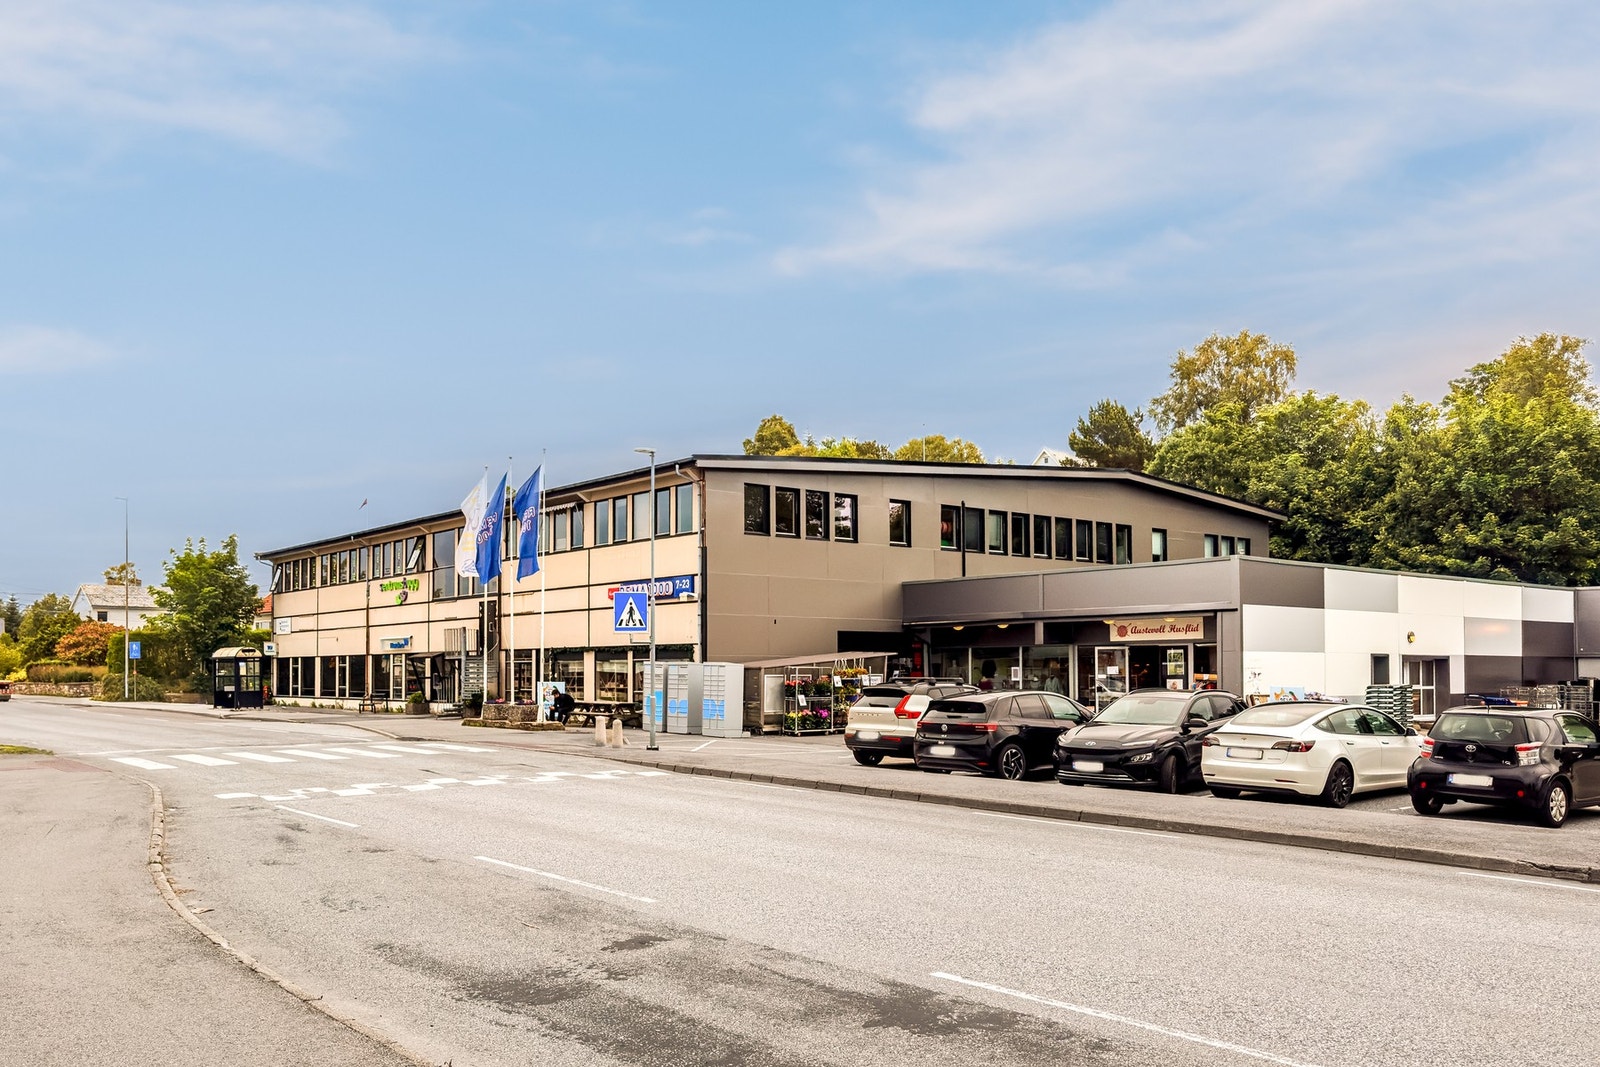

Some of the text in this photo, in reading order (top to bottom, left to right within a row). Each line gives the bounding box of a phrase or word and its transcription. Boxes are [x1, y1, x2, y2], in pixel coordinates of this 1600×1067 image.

[675, 579, 690, 589] 7-23
[1131, 624, 1199, 635] Austevoll Husflid
